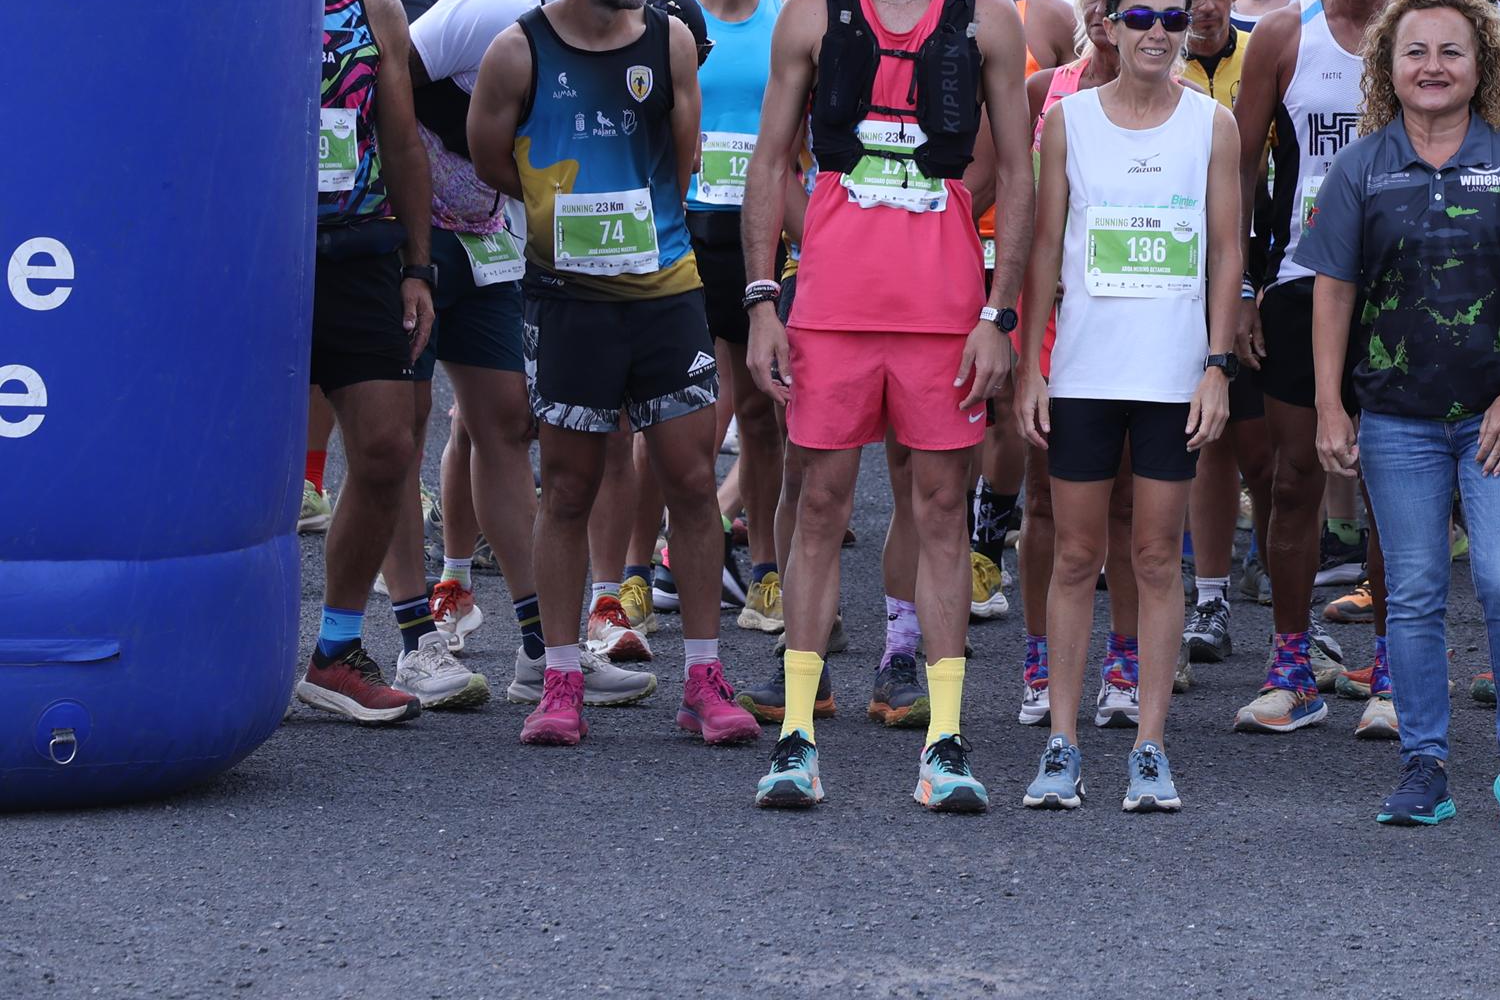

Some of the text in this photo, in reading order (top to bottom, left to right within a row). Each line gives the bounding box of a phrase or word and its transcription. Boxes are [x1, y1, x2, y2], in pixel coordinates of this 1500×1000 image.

[1322, 72, 1342, 80] TACTIC
[942, 44, 960, 133] KIPRUN
[732, 141, 744, 150] 23
[885, 132, 899, 143] 23
[562, 202, 624, 213] RUNNING 23 Km
[1095, 216, 1161, 228] RUNNING 23 Km
[600, 220, 625, 245] 74
[1127, 236, 1167, 263] 136
[7, 237, 75, 311] e
[0, 364, 48, 438] e
